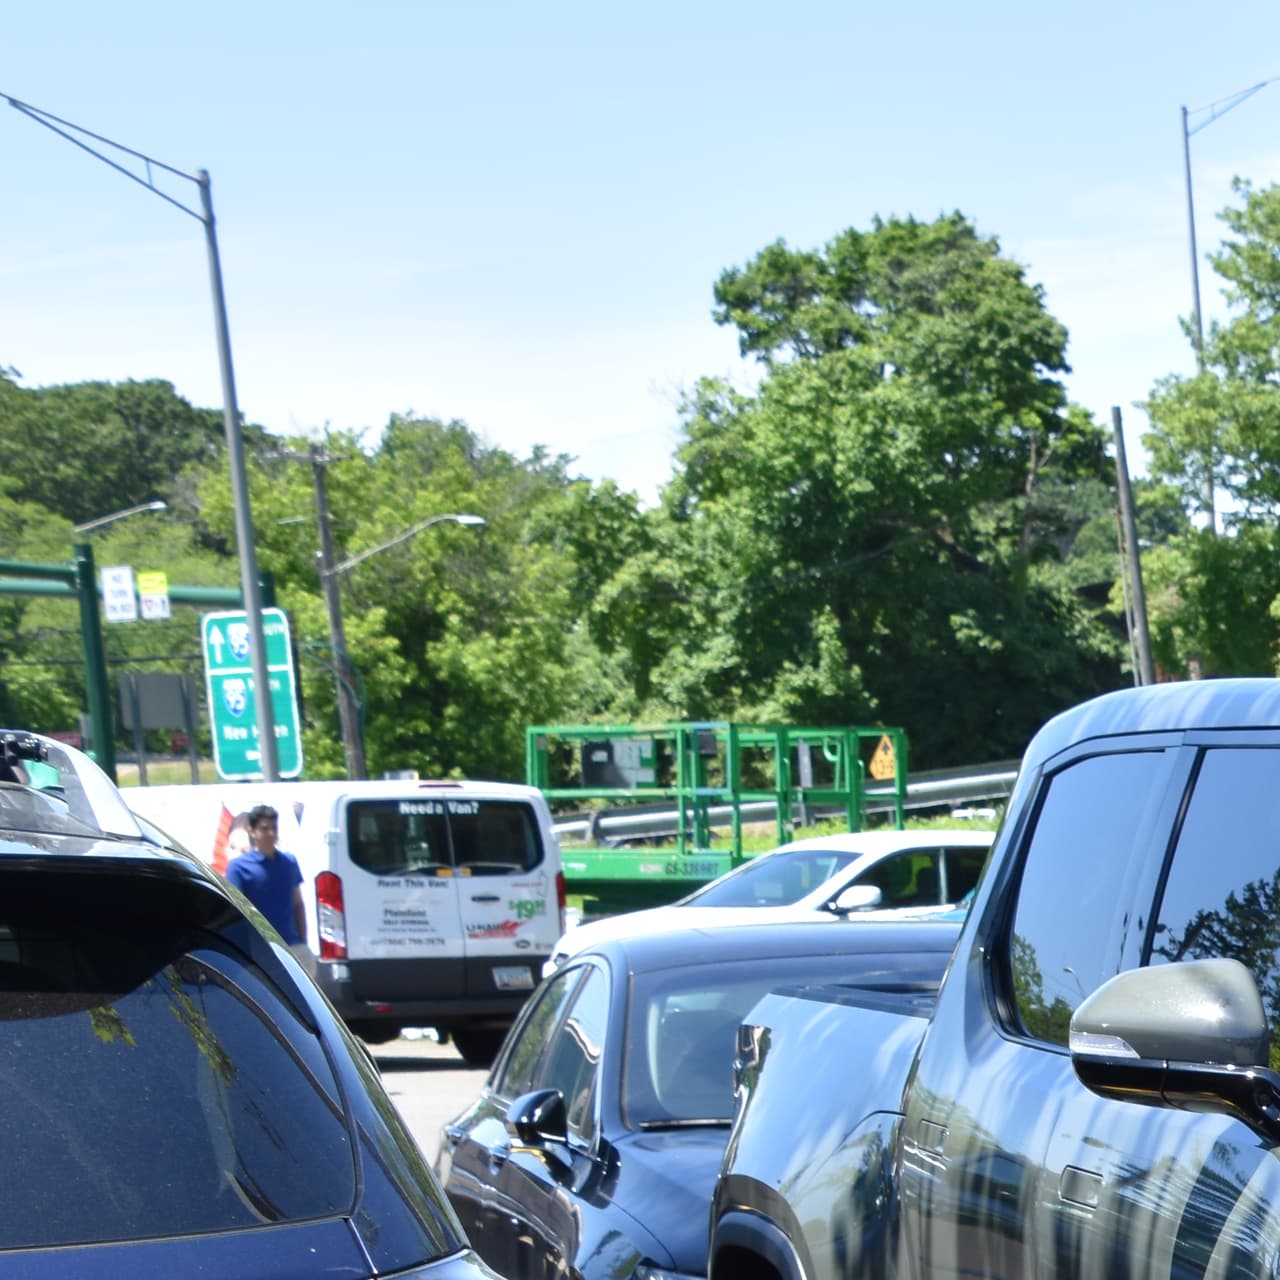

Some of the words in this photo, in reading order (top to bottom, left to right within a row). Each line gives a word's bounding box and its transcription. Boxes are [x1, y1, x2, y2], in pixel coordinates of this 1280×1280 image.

[223, 724, 248, 741] New
[399, 800, 434, 815] Need
[435, 803, 444, 815] a
[447, 800, 480, 815] Van?
[377, 879, 401, 888] Rent
[404, 878, 425, 888] This
